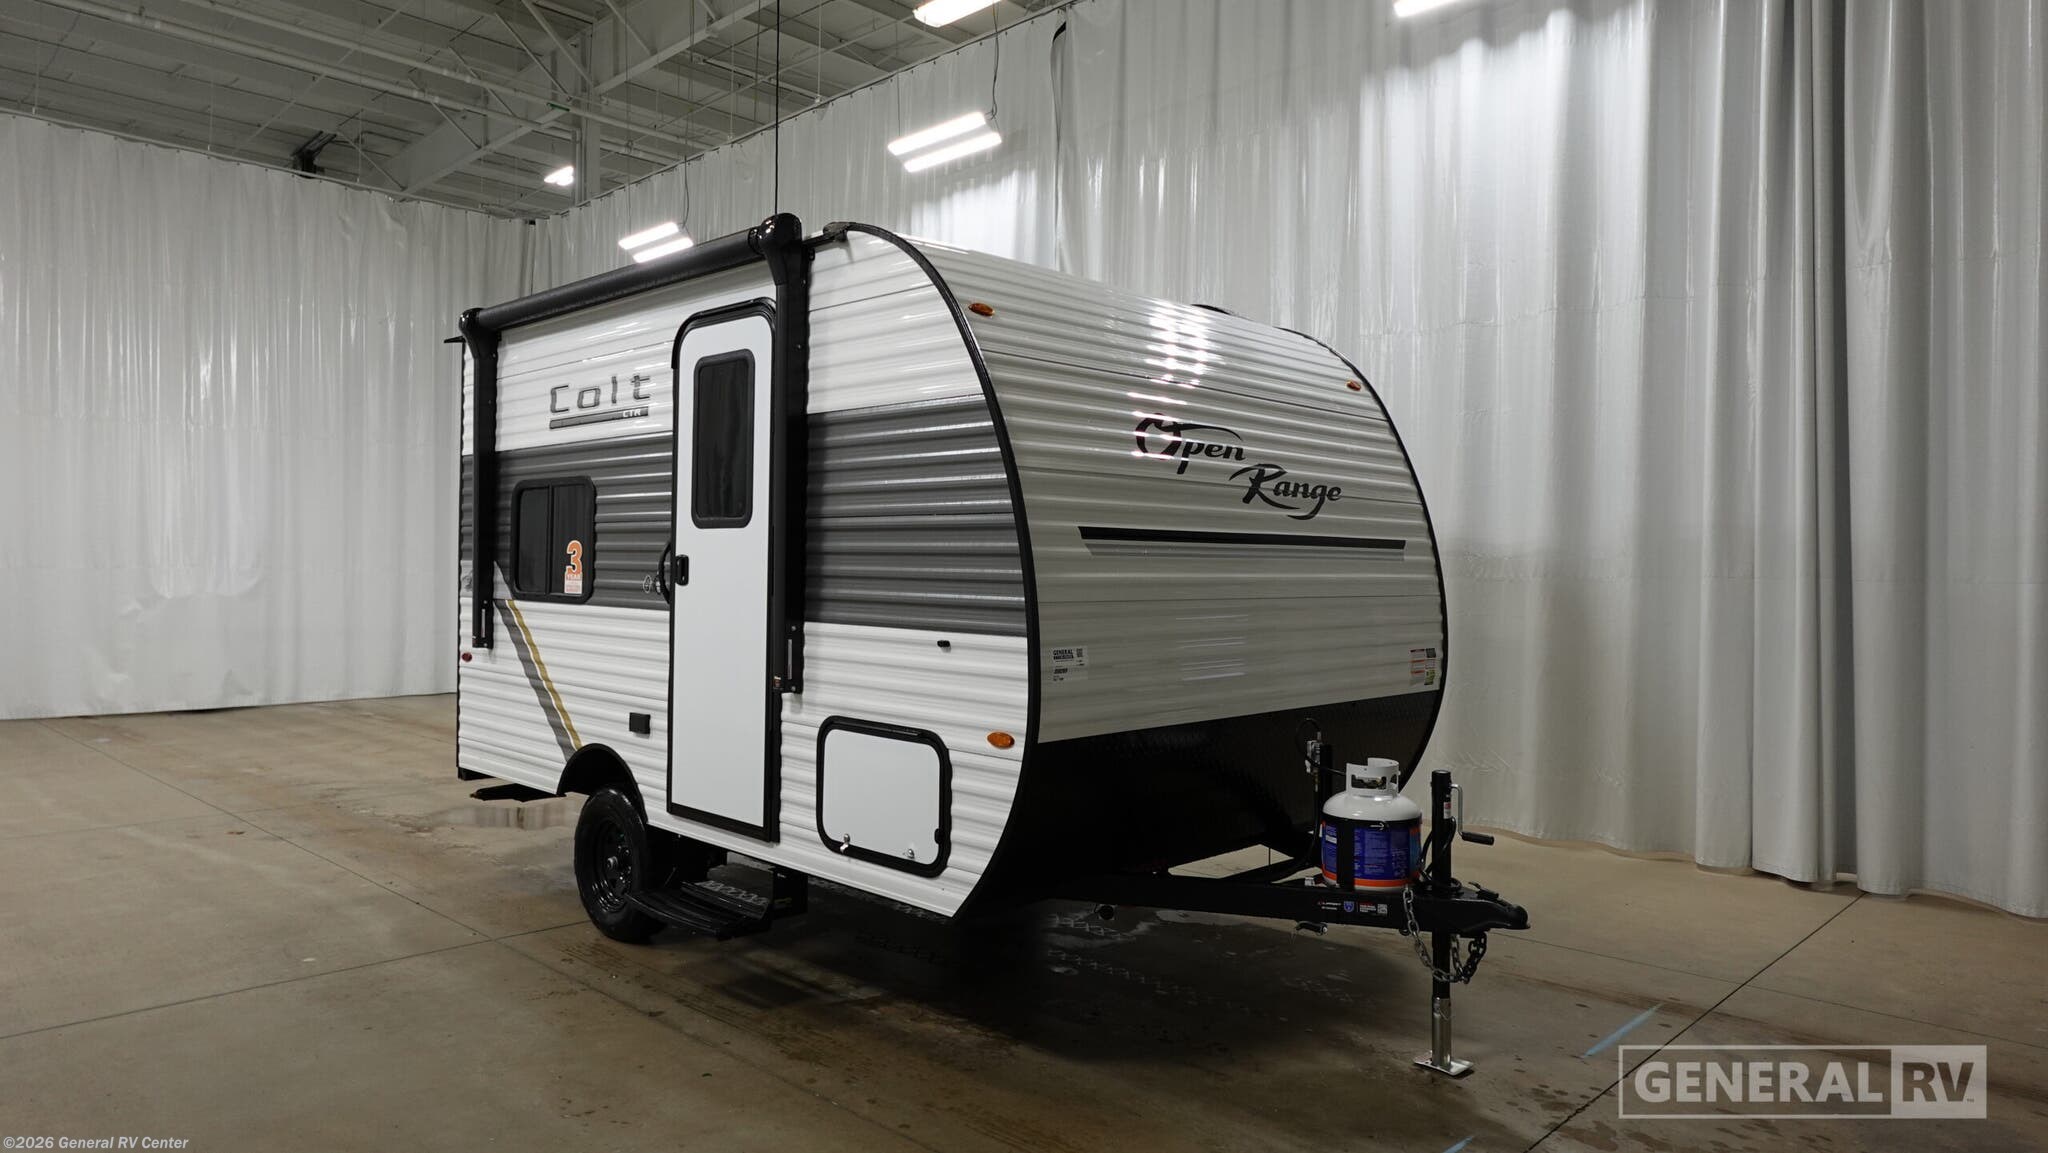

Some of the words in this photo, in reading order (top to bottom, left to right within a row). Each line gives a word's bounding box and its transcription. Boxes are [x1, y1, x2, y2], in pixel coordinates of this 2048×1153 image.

[550, 375, 650, 413] Colt
[622, 408, 641, 419] CTR
[1135, 412, 1247, 475] Open
[1229, 463, 1342, 520] Range
[566, 540, 583, 575] 3
